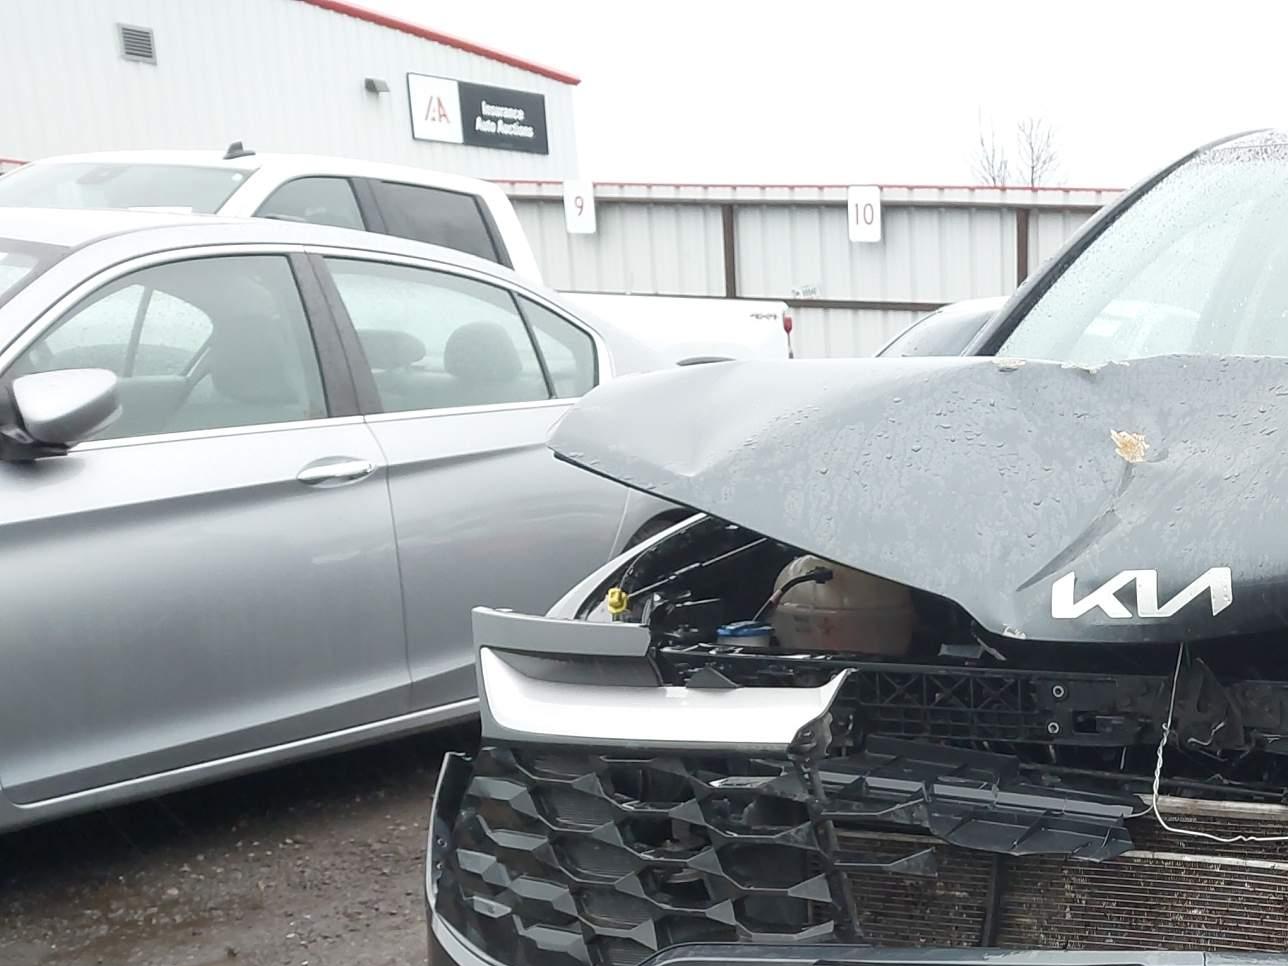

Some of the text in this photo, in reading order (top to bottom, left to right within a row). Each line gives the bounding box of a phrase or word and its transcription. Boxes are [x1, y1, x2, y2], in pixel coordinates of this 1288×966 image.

[481, 100, 525, 121] Insurance
[475, 116, 534, 138] Auto Auctions
[575, 195, 584, 217] 9
[855, 203, 874, 225] 10
[1051, 566, 1233, 619] KIA
